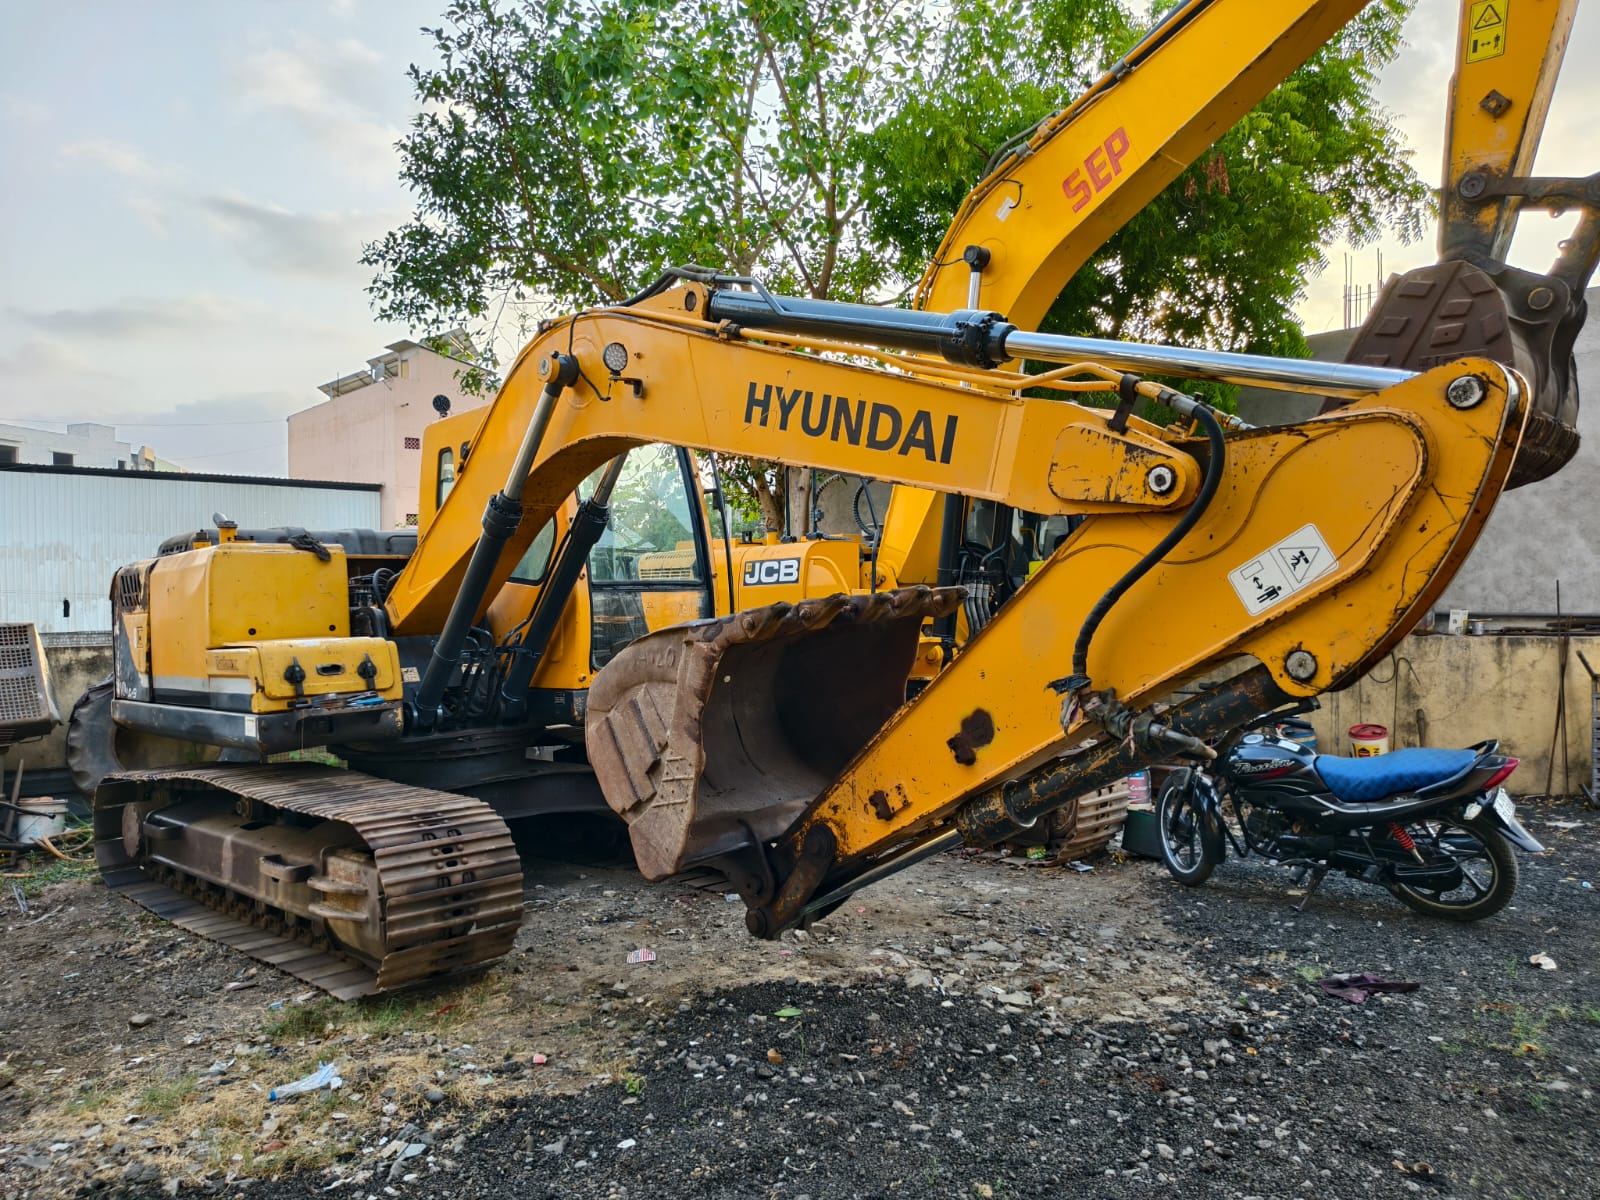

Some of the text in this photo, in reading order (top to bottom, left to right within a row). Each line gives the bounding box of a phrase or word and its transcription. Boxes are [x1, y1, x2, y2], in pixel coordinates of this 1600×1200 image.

[1062, 126, 1130, 213] SEP
[744, 381, 959, 465] HYUNDAI
[744, 559, 799, 584] JCB
